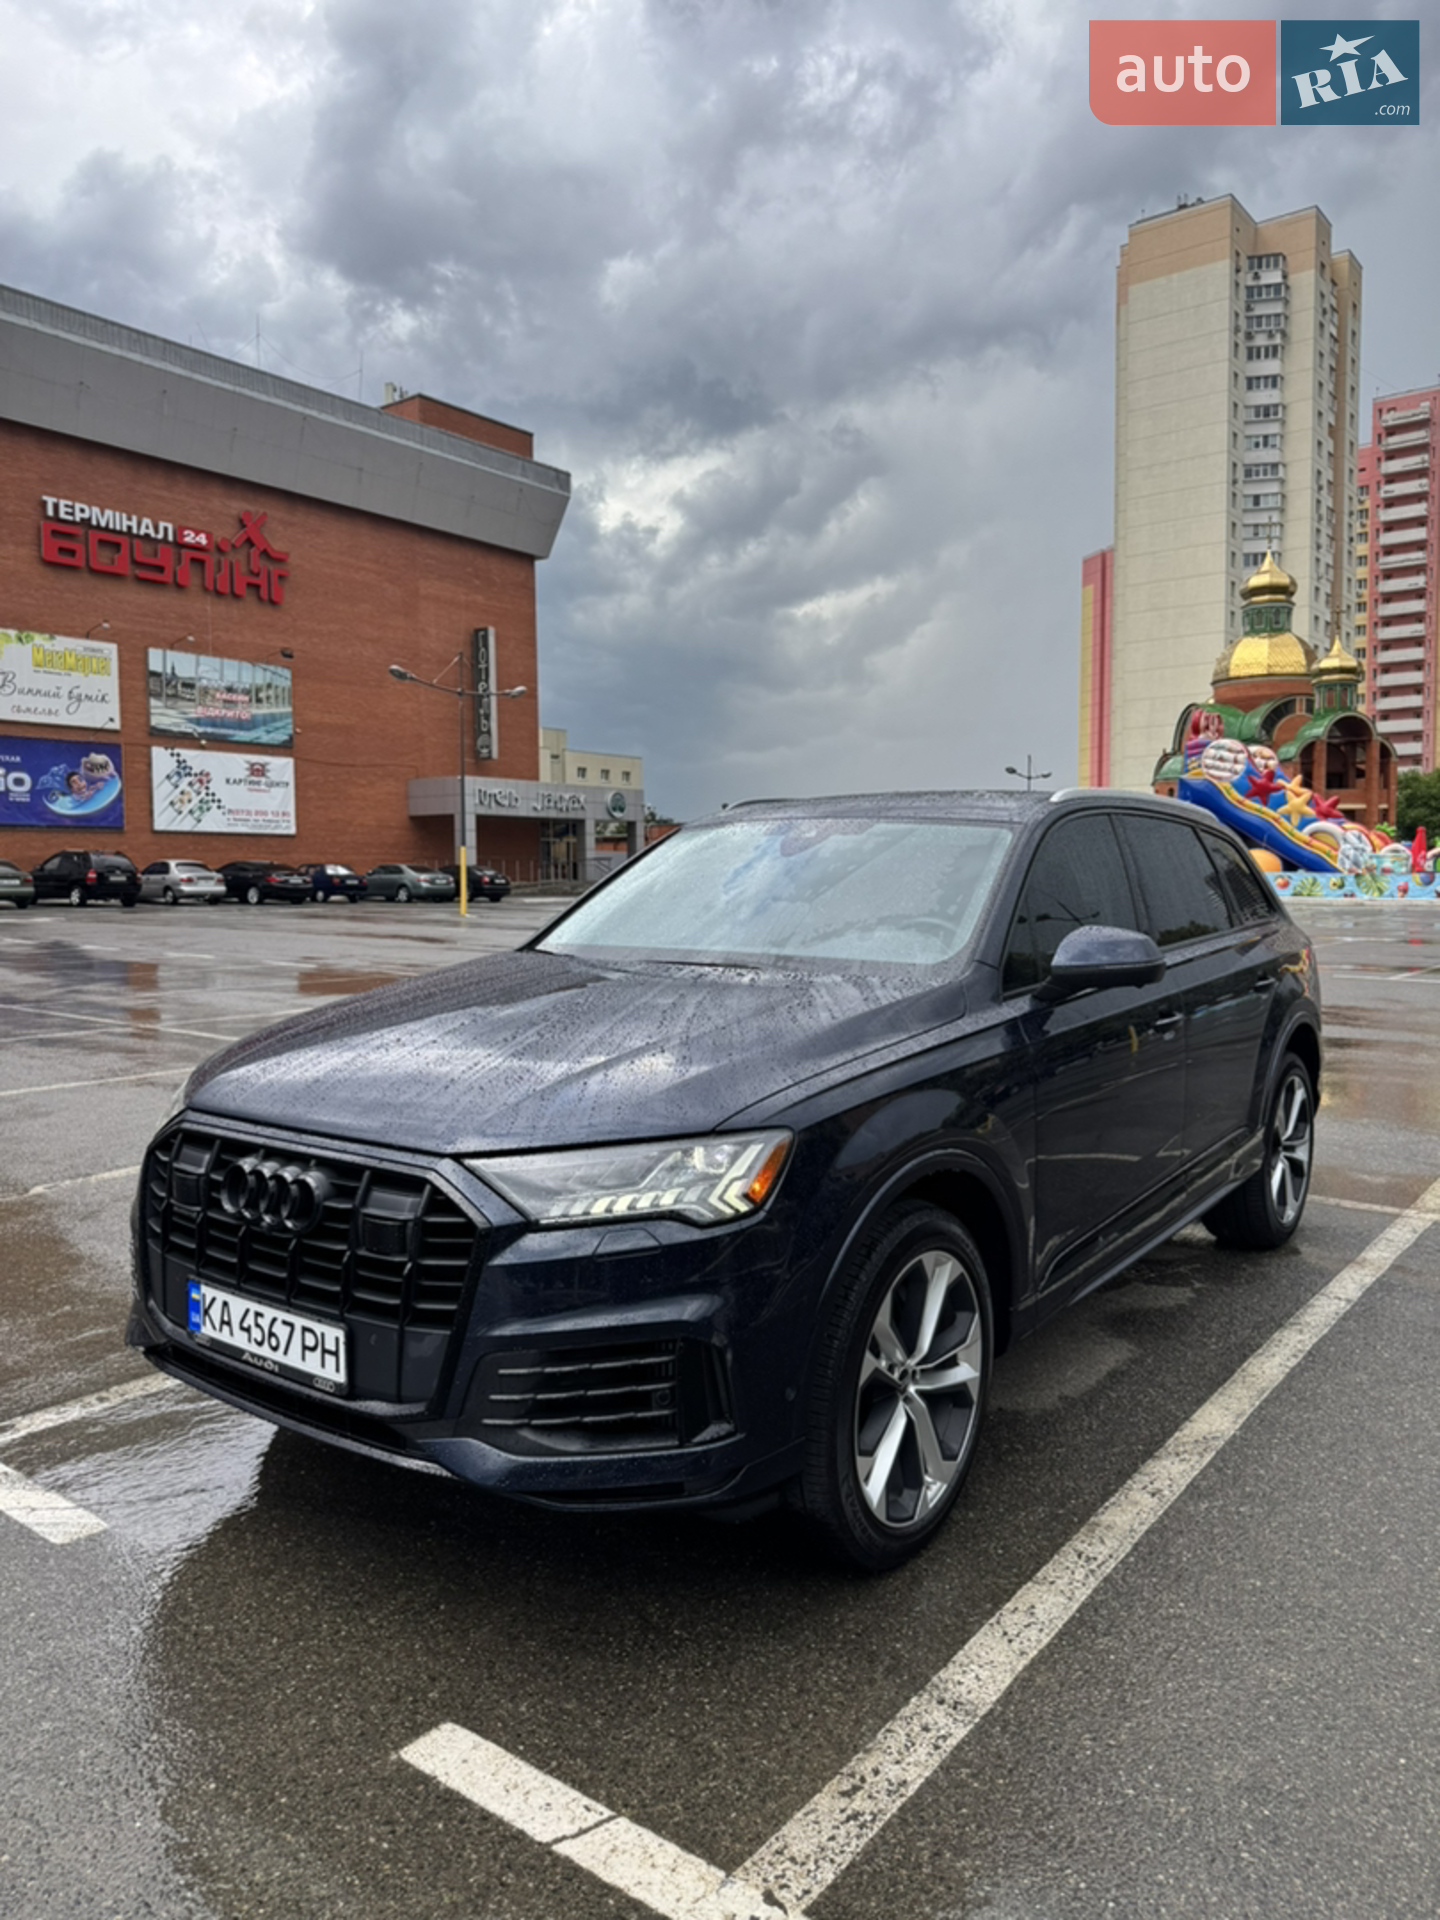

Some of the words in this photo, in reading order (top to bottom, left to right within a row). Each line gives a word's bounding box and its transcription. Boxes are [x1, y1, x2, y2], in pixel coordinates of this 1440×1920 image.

[42, 495, 174, 542] ТЕРМІНАЛ
[183, 529, 207, 545] 24
[41, 521, 290, 605] БОУЛІНГ
[67, 685, 111, 715] бутік
[239, 1307, 296, 1356] 4567
